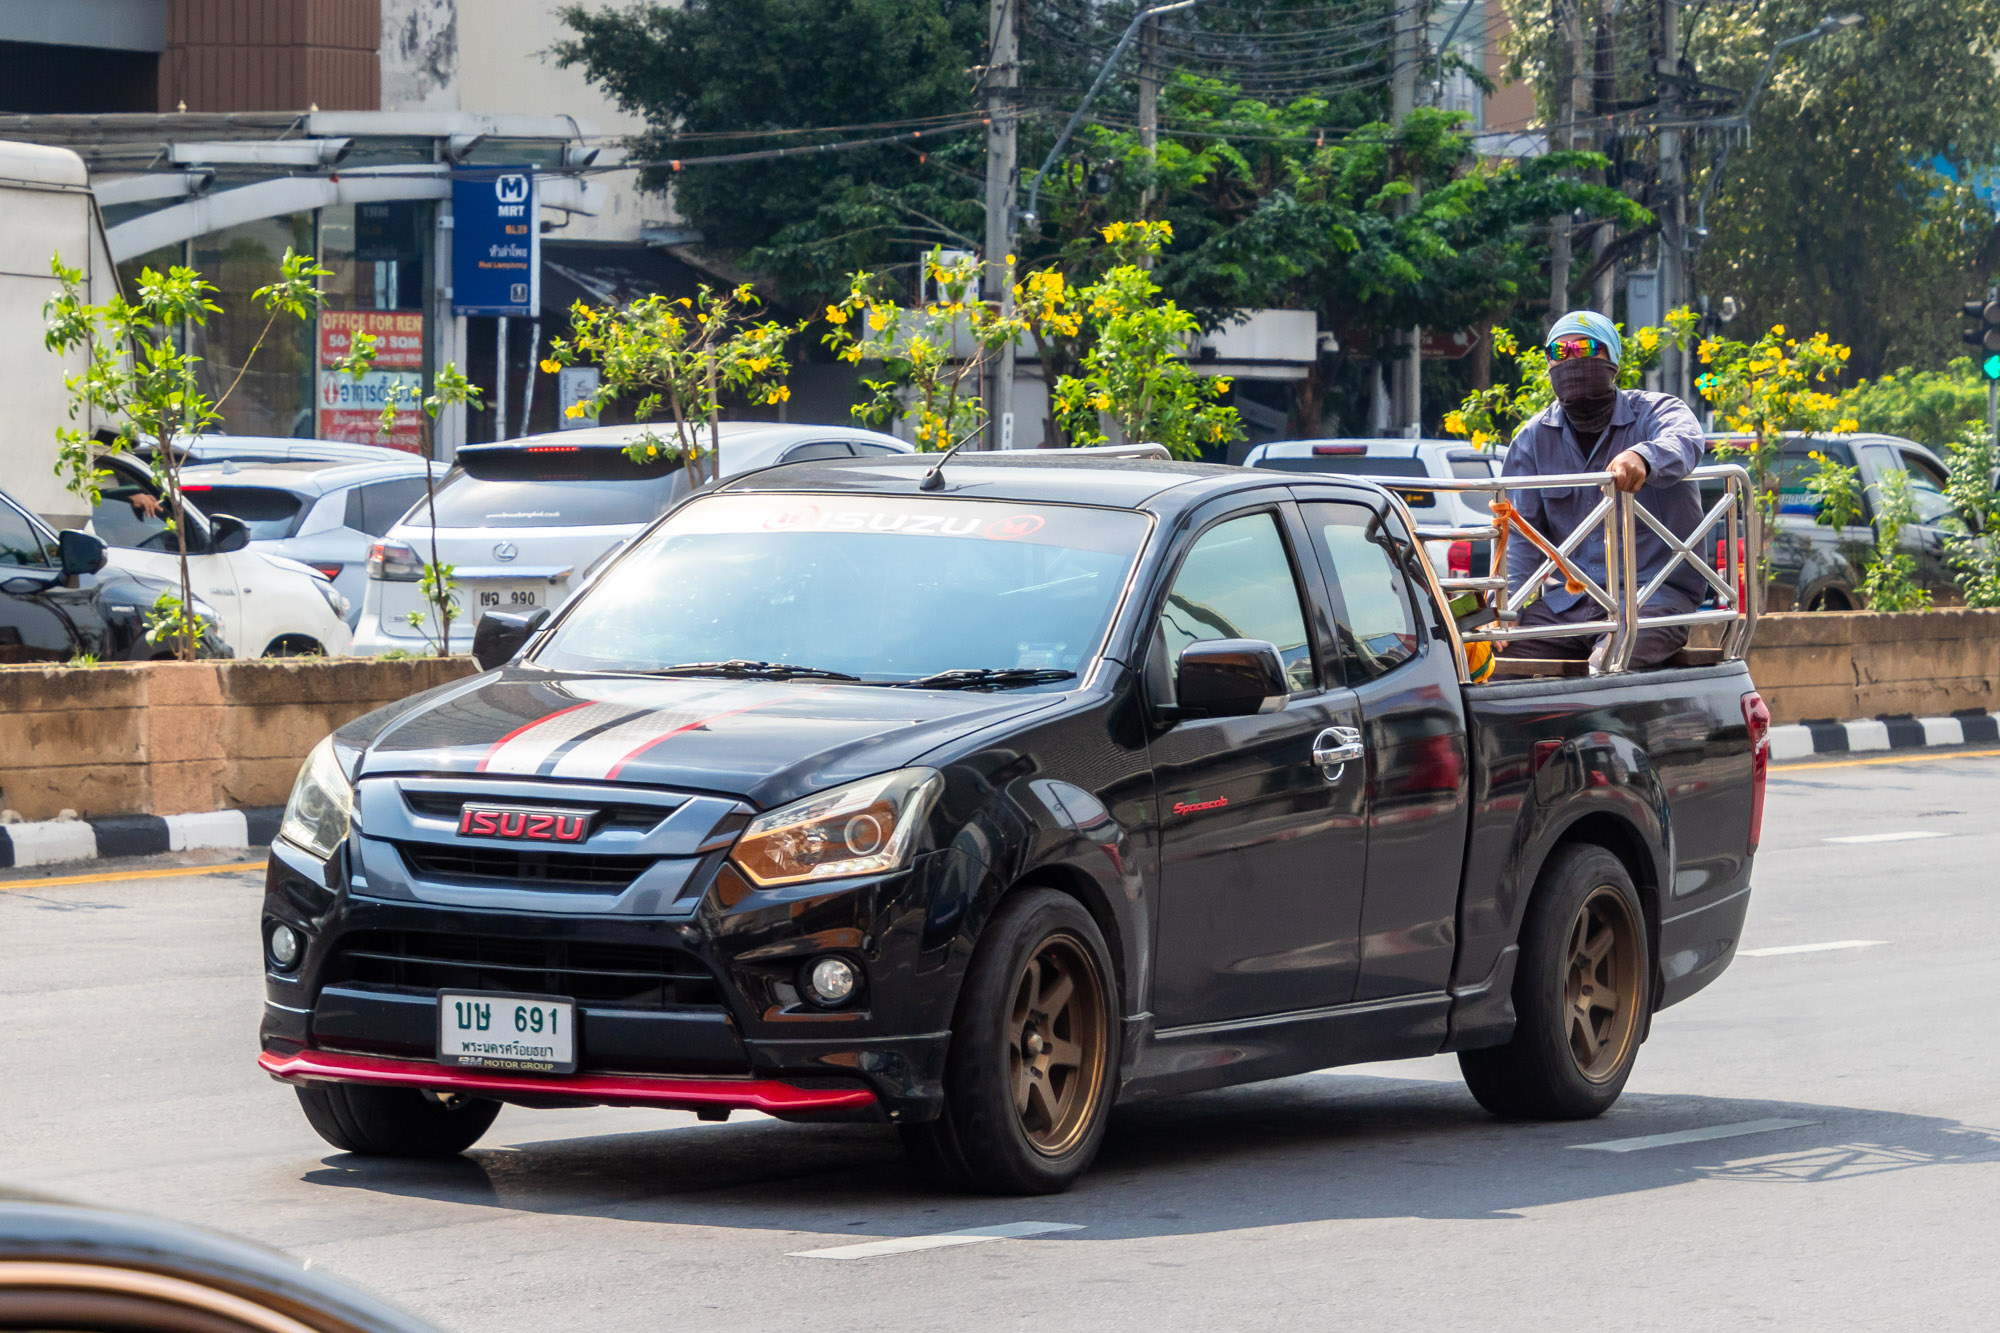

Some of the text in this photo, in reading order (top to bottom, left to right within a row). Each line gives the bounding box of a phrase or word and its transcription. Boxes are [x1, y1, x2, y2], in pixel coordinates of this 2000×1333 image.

[498, 205, 525, 217] MRT
[323, 313, 366, 331] OFFICE
[369, 314, 393, 331] FOR
[815, 511, 983, 535] ISUZU
[511, 591, 536, 606] 990
[460, 810, 584, 840] ISUZU
[455, 1001, 558, 1035] บษ 691
[461, 1040, 554, 1060] พระนครศรีอยธยา
[483, 1058, 519, 1070] MOTOR
[520, 1061, 555, 1072] GROUP
